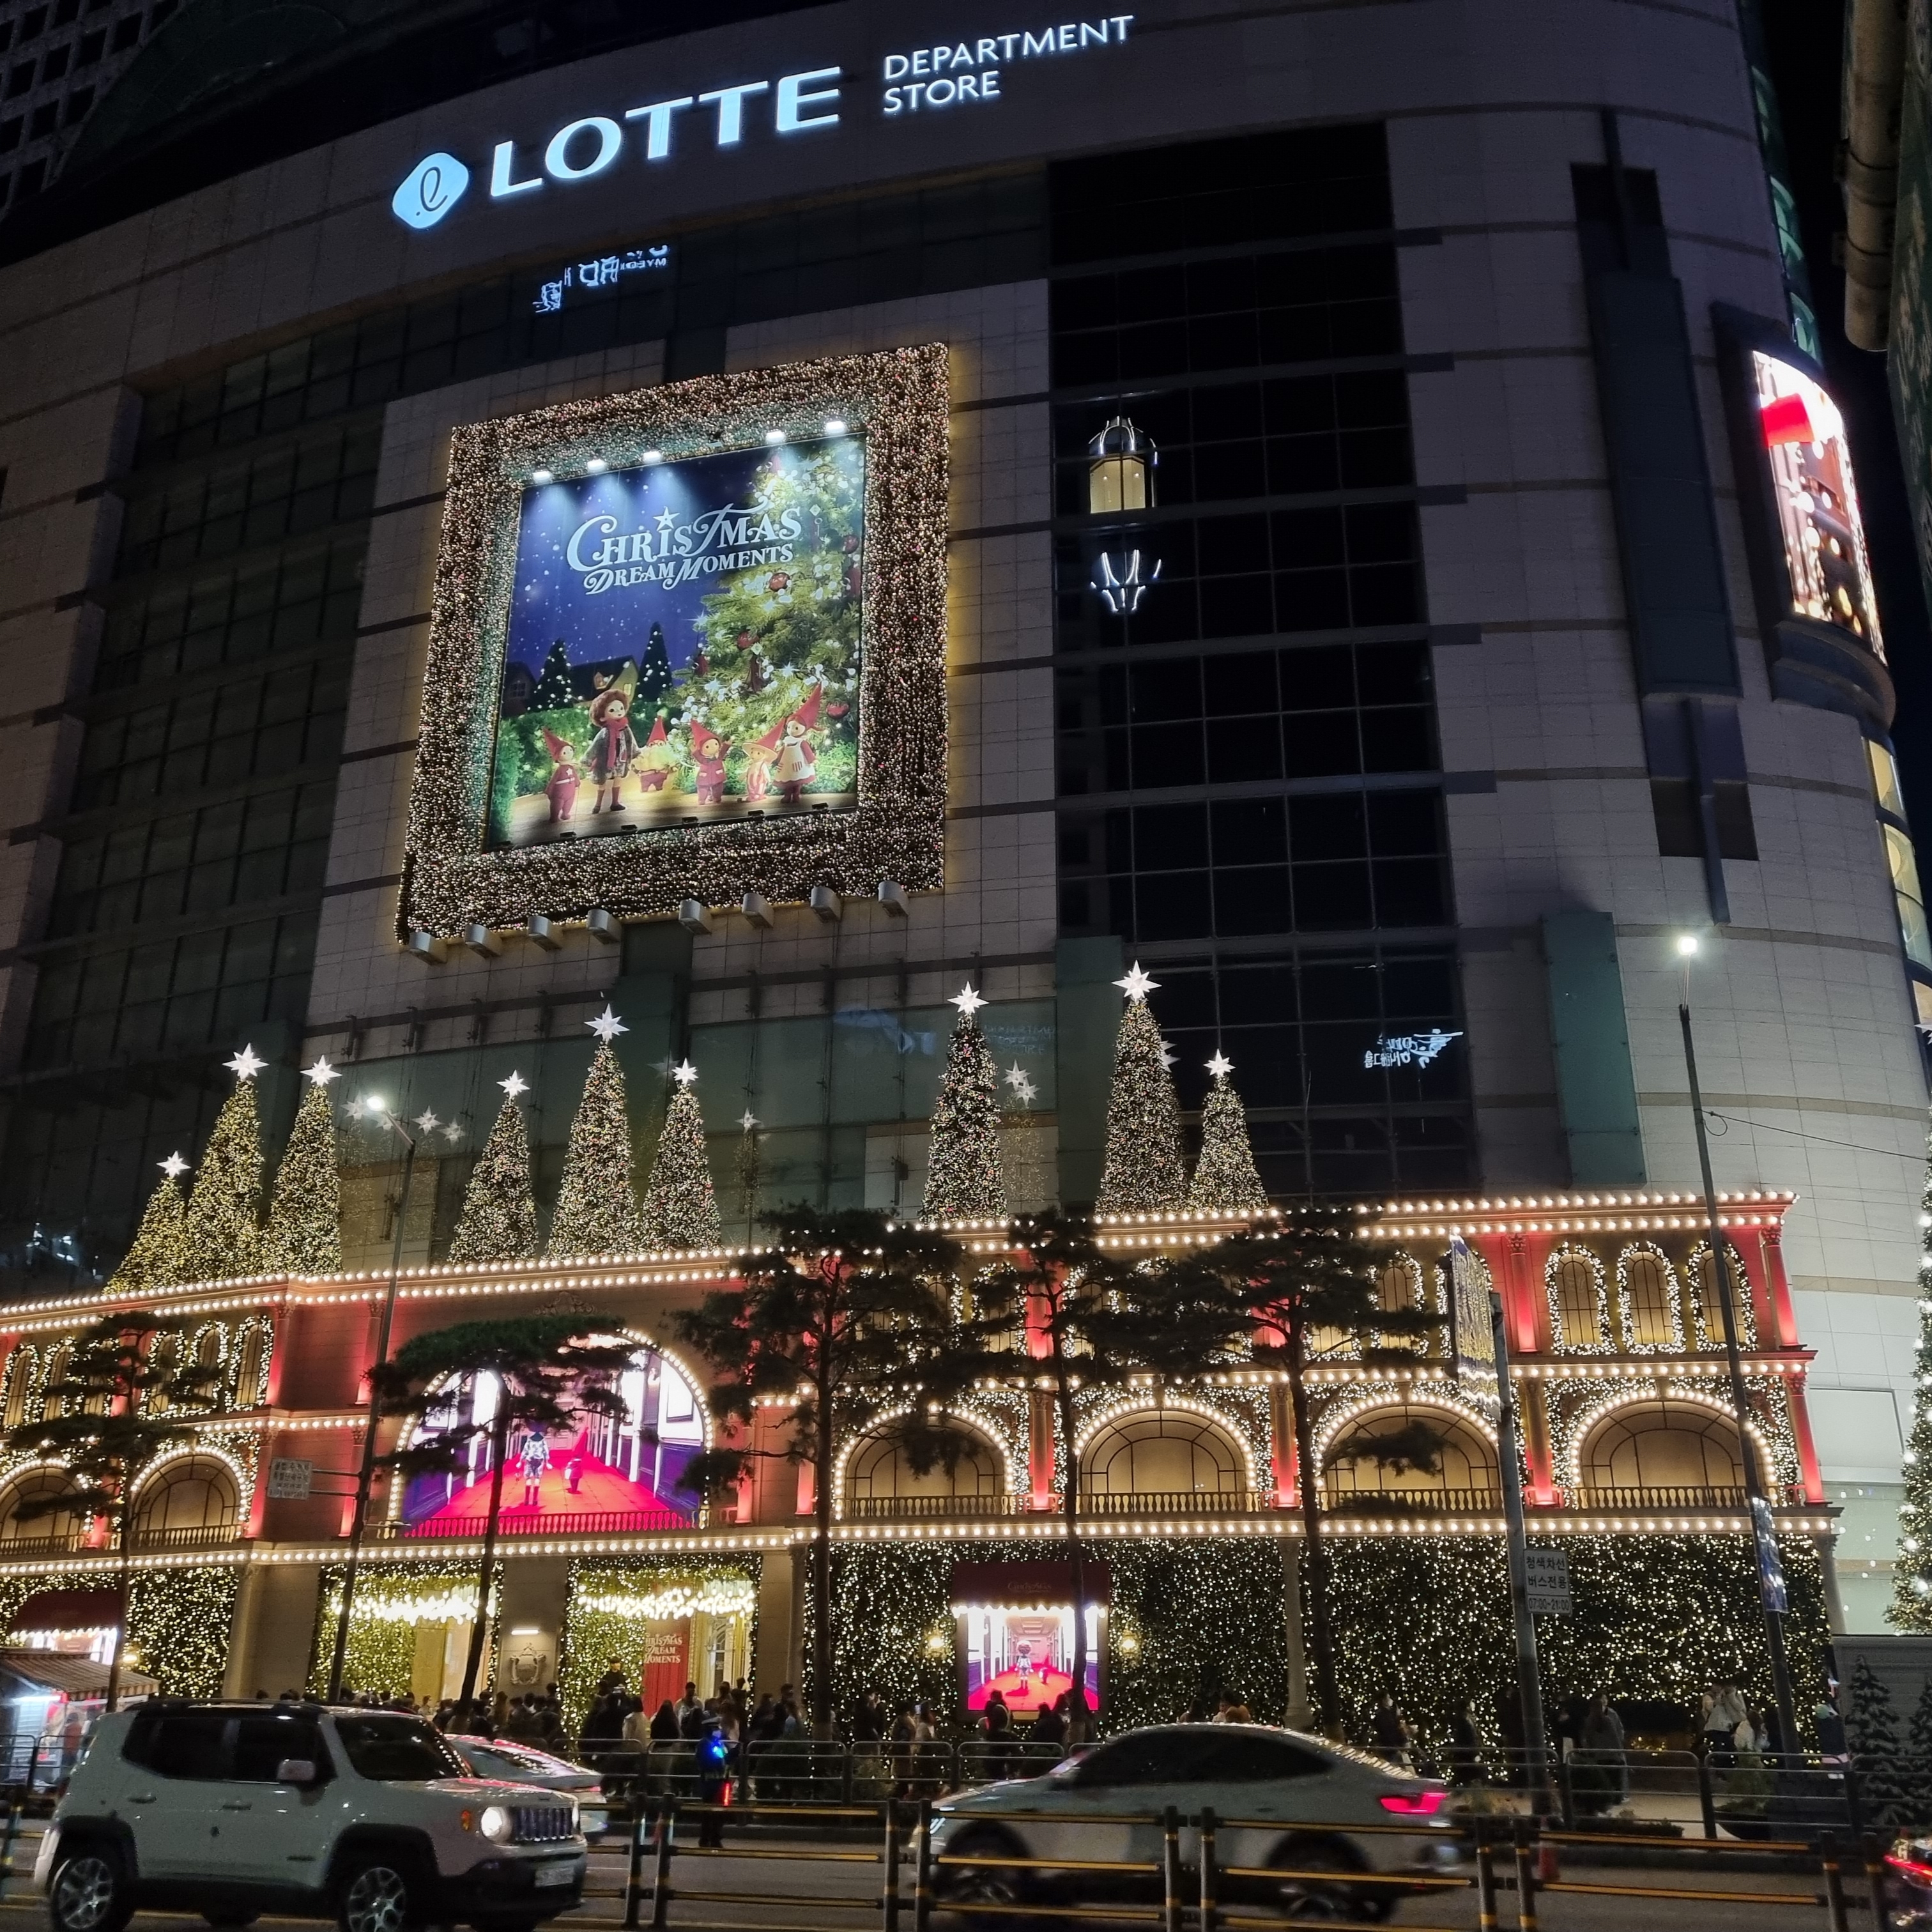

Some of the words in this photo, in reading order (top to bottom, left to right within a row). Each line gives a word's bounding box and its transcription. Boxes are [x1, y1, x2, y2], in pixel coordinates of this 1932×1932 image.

[885, 15, 1133, 80] DEPARTMENT
[883, 70, 1000, 113] STORE
[491, 66, 840, 197] LOTTE
[566, 496, 802, 572] CHRISTMAS
[583, 561, 675, 595] DREAM
[663, 543, 793, 590] MOMENTS
[1526, 1556, 1565, 1570] 청색차선
[1528, 1575, 1567, 1589] 버스전용
[645, 1645, 676, 1655] DREAM
